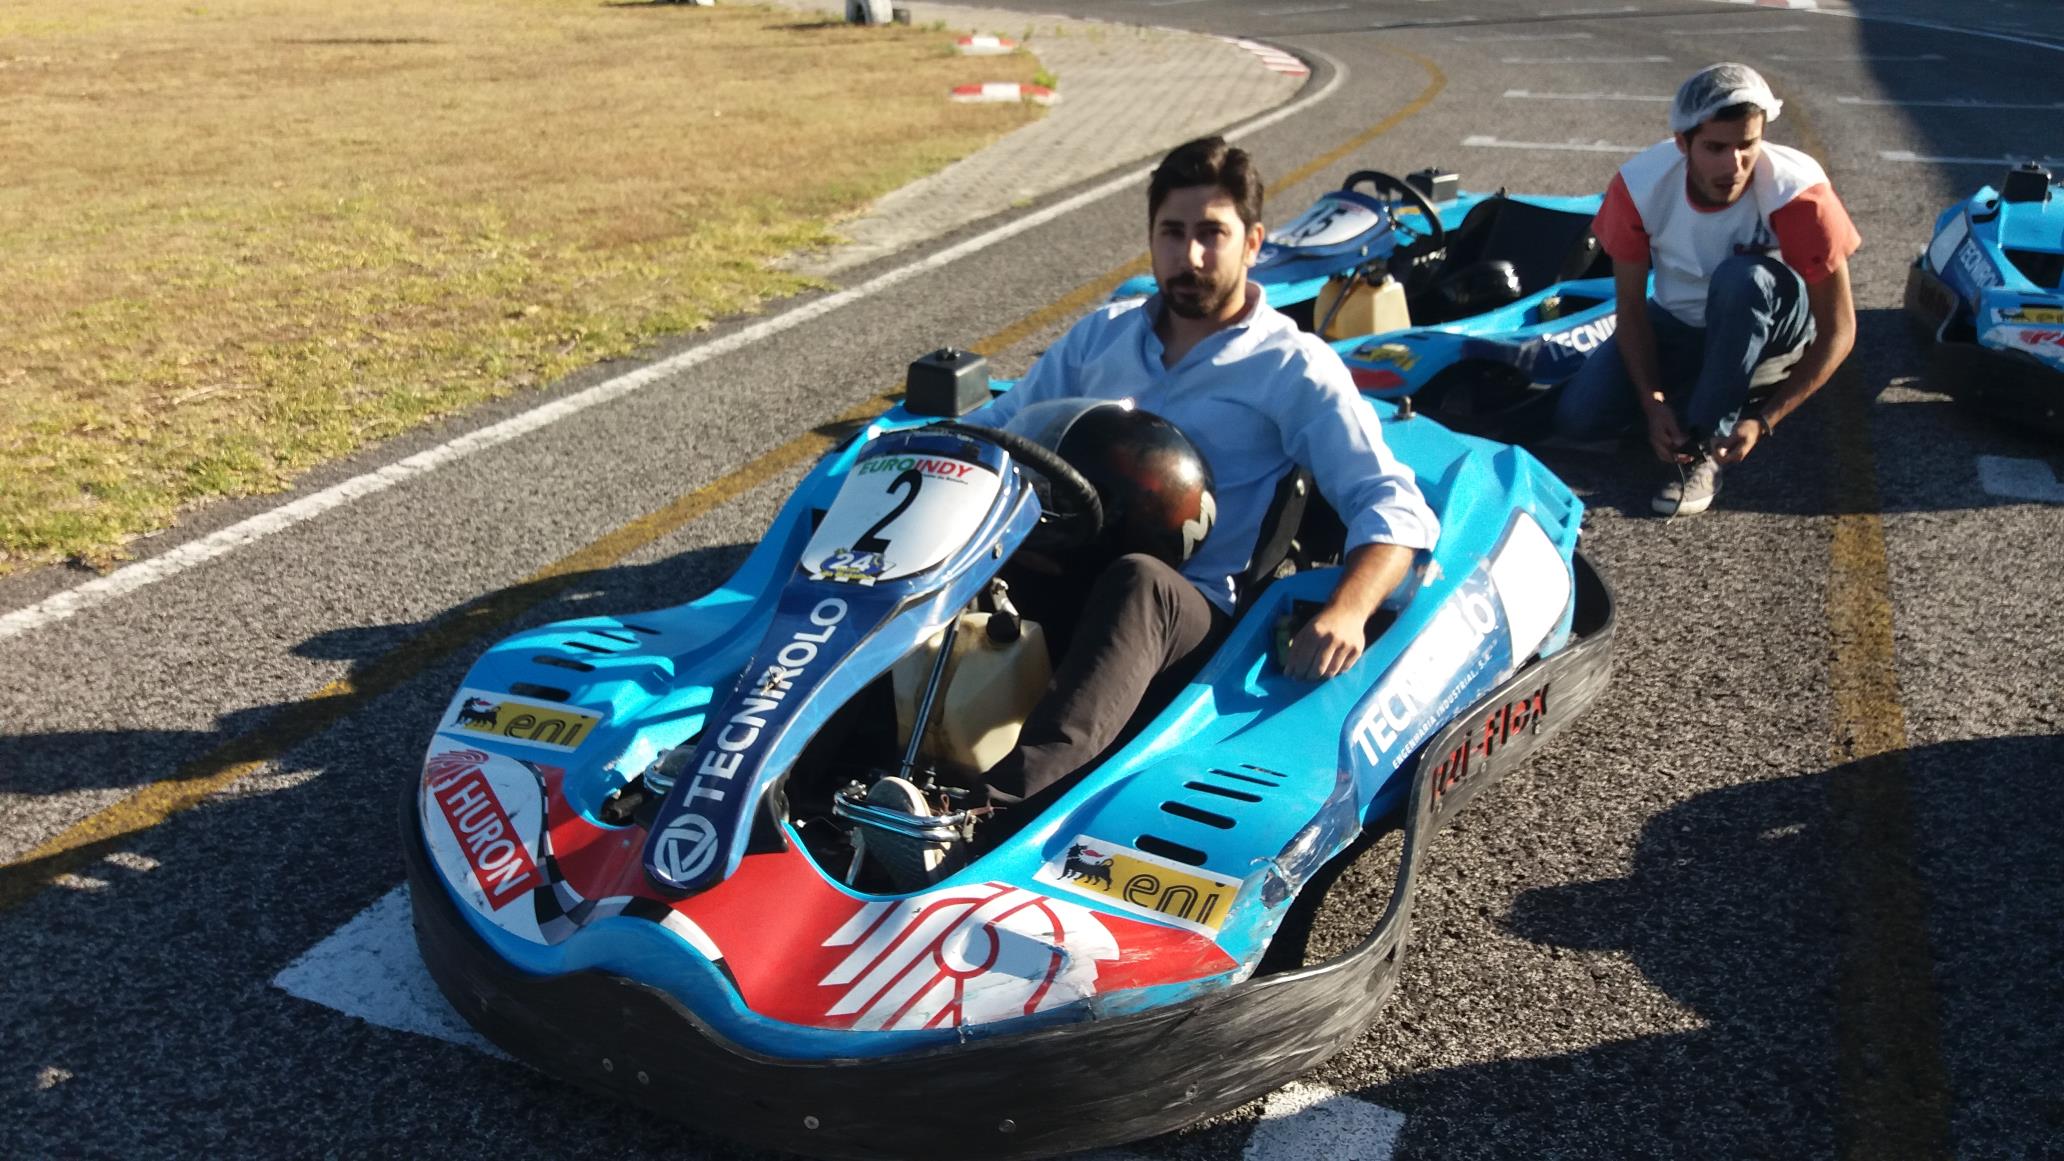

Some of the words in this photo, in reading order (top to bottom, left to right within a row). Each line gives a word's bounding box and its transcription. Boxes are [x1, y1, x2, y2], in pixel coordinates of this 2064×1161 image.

[858, 456, 974, 478] EUROINDY
[850, 468, 922, 554] 2
[828, 552, 872, 572] 24
[683, 597, 849, 808] TECNIROLO
[503, 713, 589, 747] eni
[446, 780, 531, 897] HURON
[1122, 873, 1227, 926] eni
